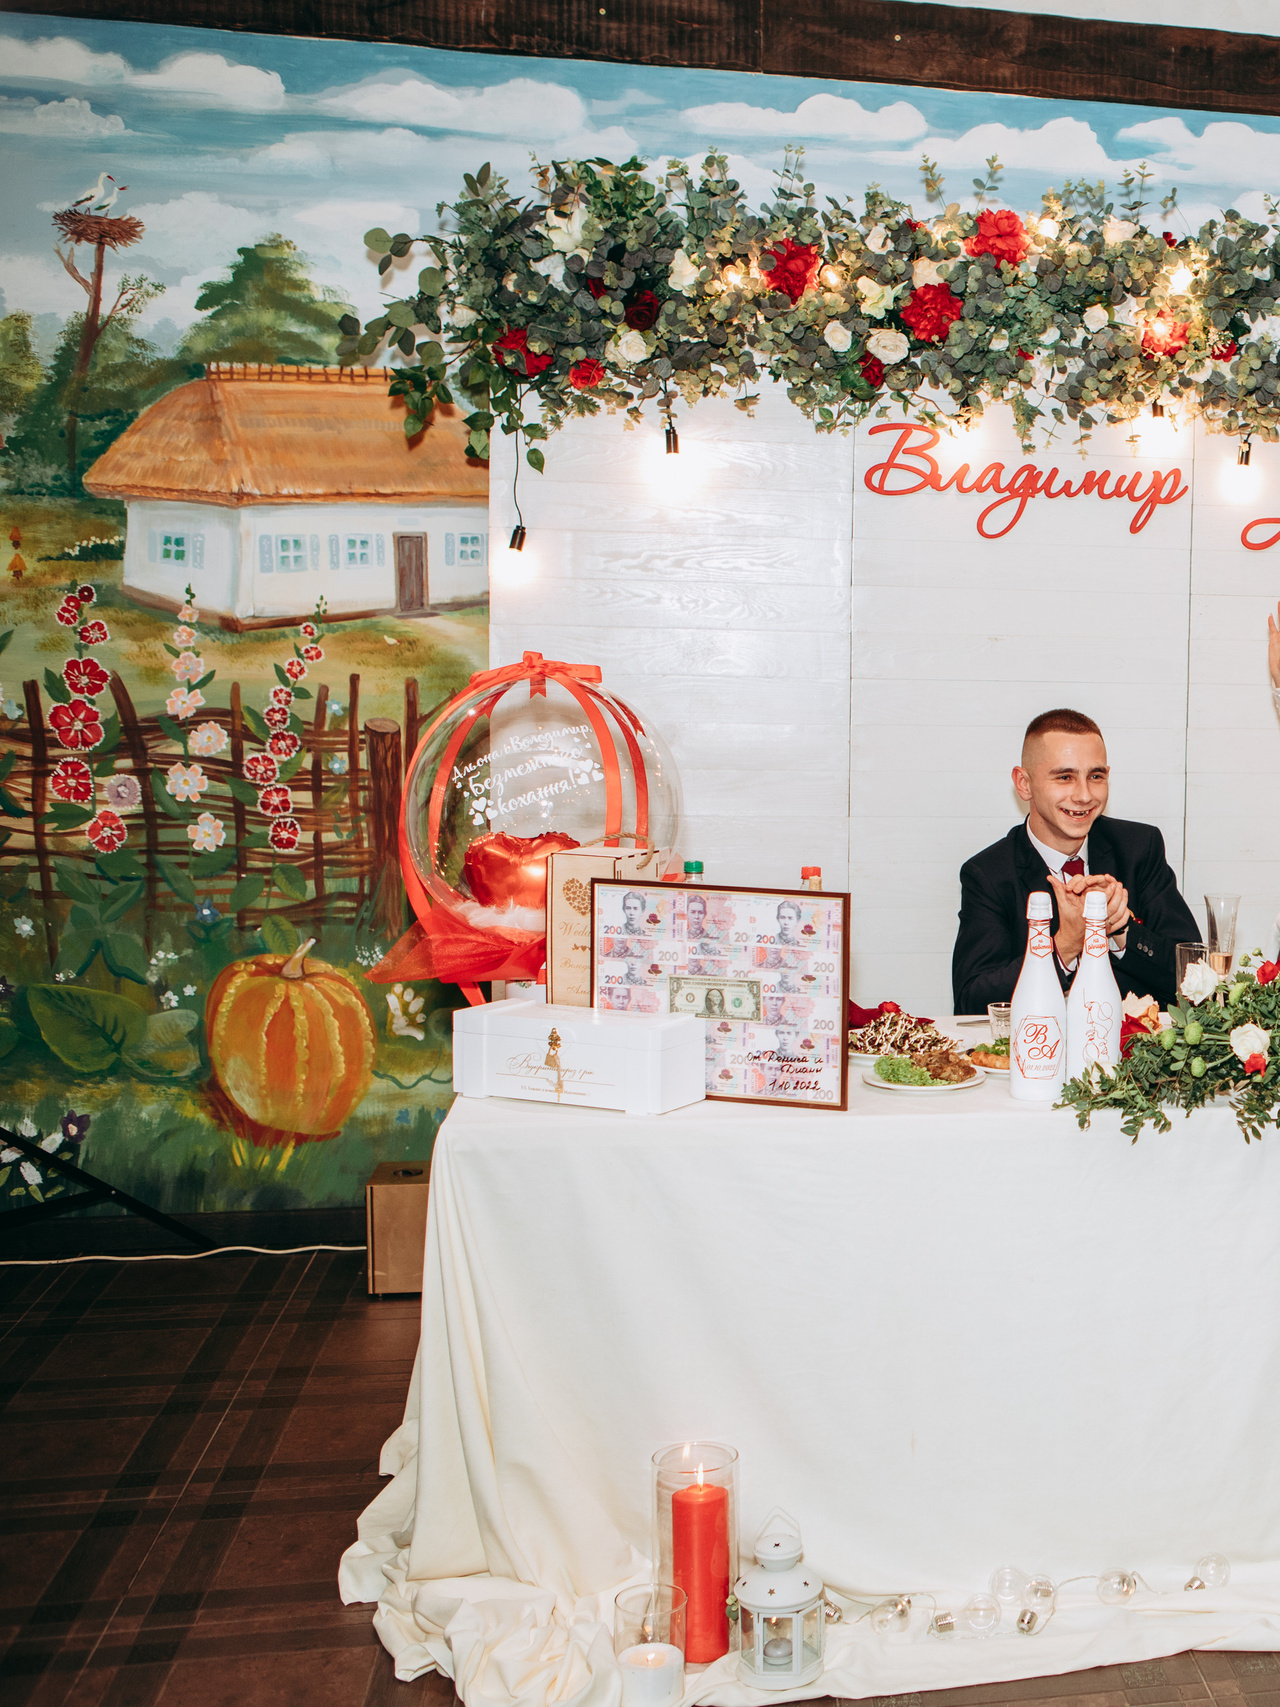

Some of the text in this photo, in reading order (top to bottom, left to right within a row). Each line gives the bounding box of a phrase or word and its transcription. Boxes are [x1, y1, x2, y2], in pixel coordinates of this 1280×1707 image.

[864, 422, 1188, 540] Владимир
[452, 750, 503, 783] Альона
[497, 768, 577, 815] кохання!
[604, 925, 622, 935] 200
[756, 934, 775, 945] 200
[659, 951, 678, 962] 200
[813, 962, 834, 973] 200
[605, 975, 623, 985] 200
[813, 1020, 834, 1030] 200
